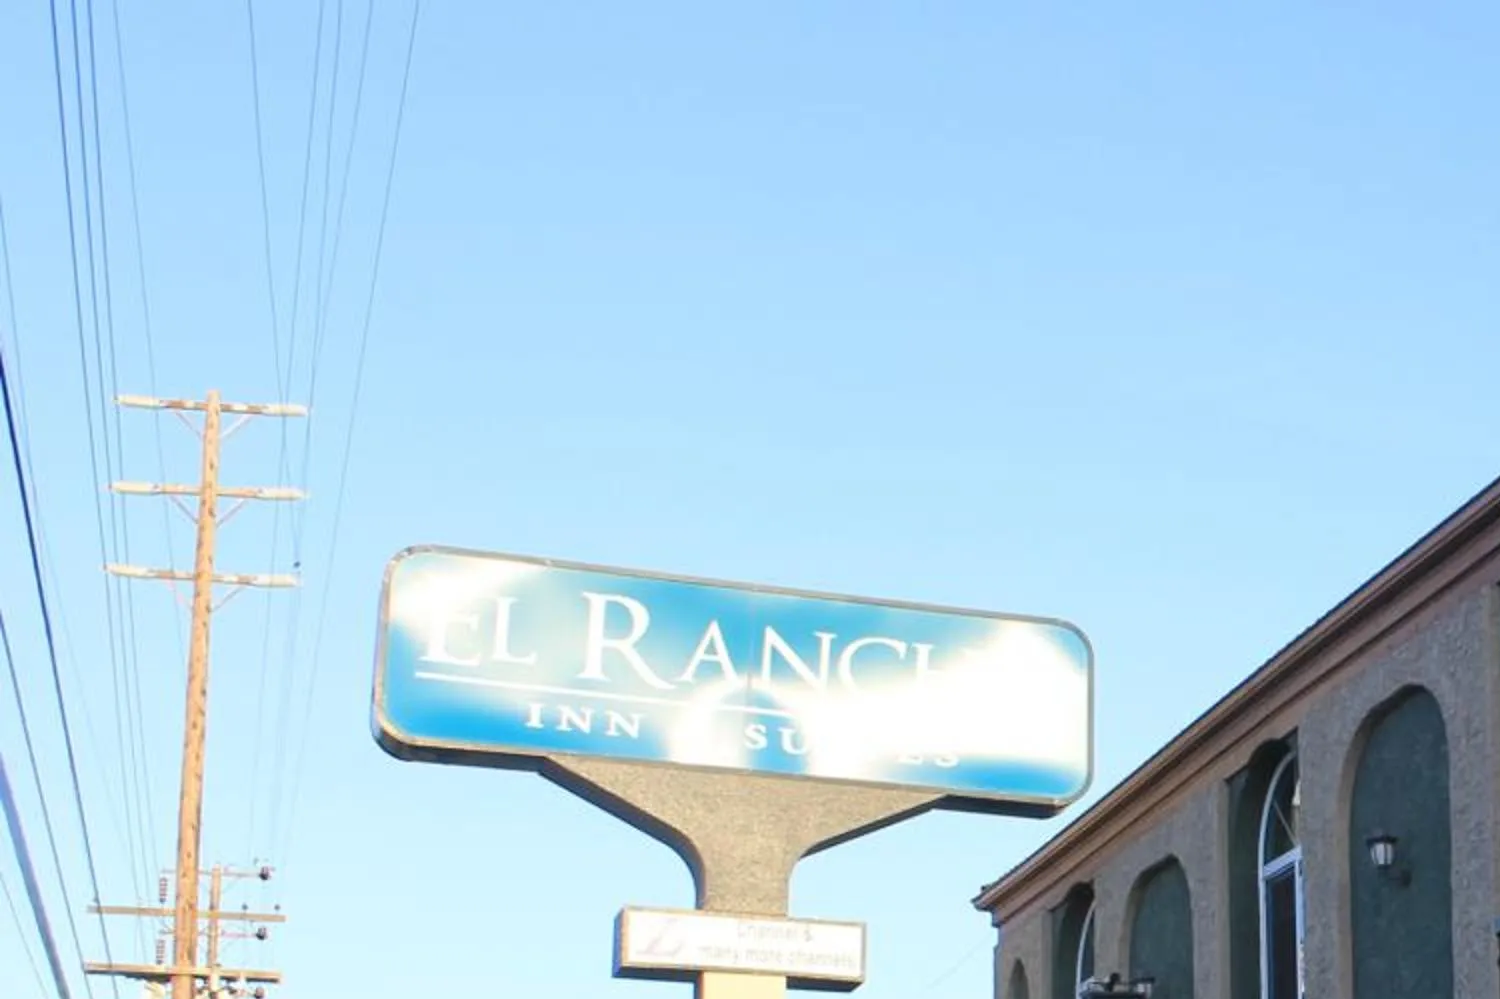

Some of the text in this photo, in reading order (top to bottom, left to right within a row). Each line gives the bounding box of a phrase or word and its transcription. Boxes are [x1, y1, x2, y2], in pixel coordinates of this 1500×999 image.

[418, 591, 944, 693] EL RANC
[524, 702, 645, 740] INN
